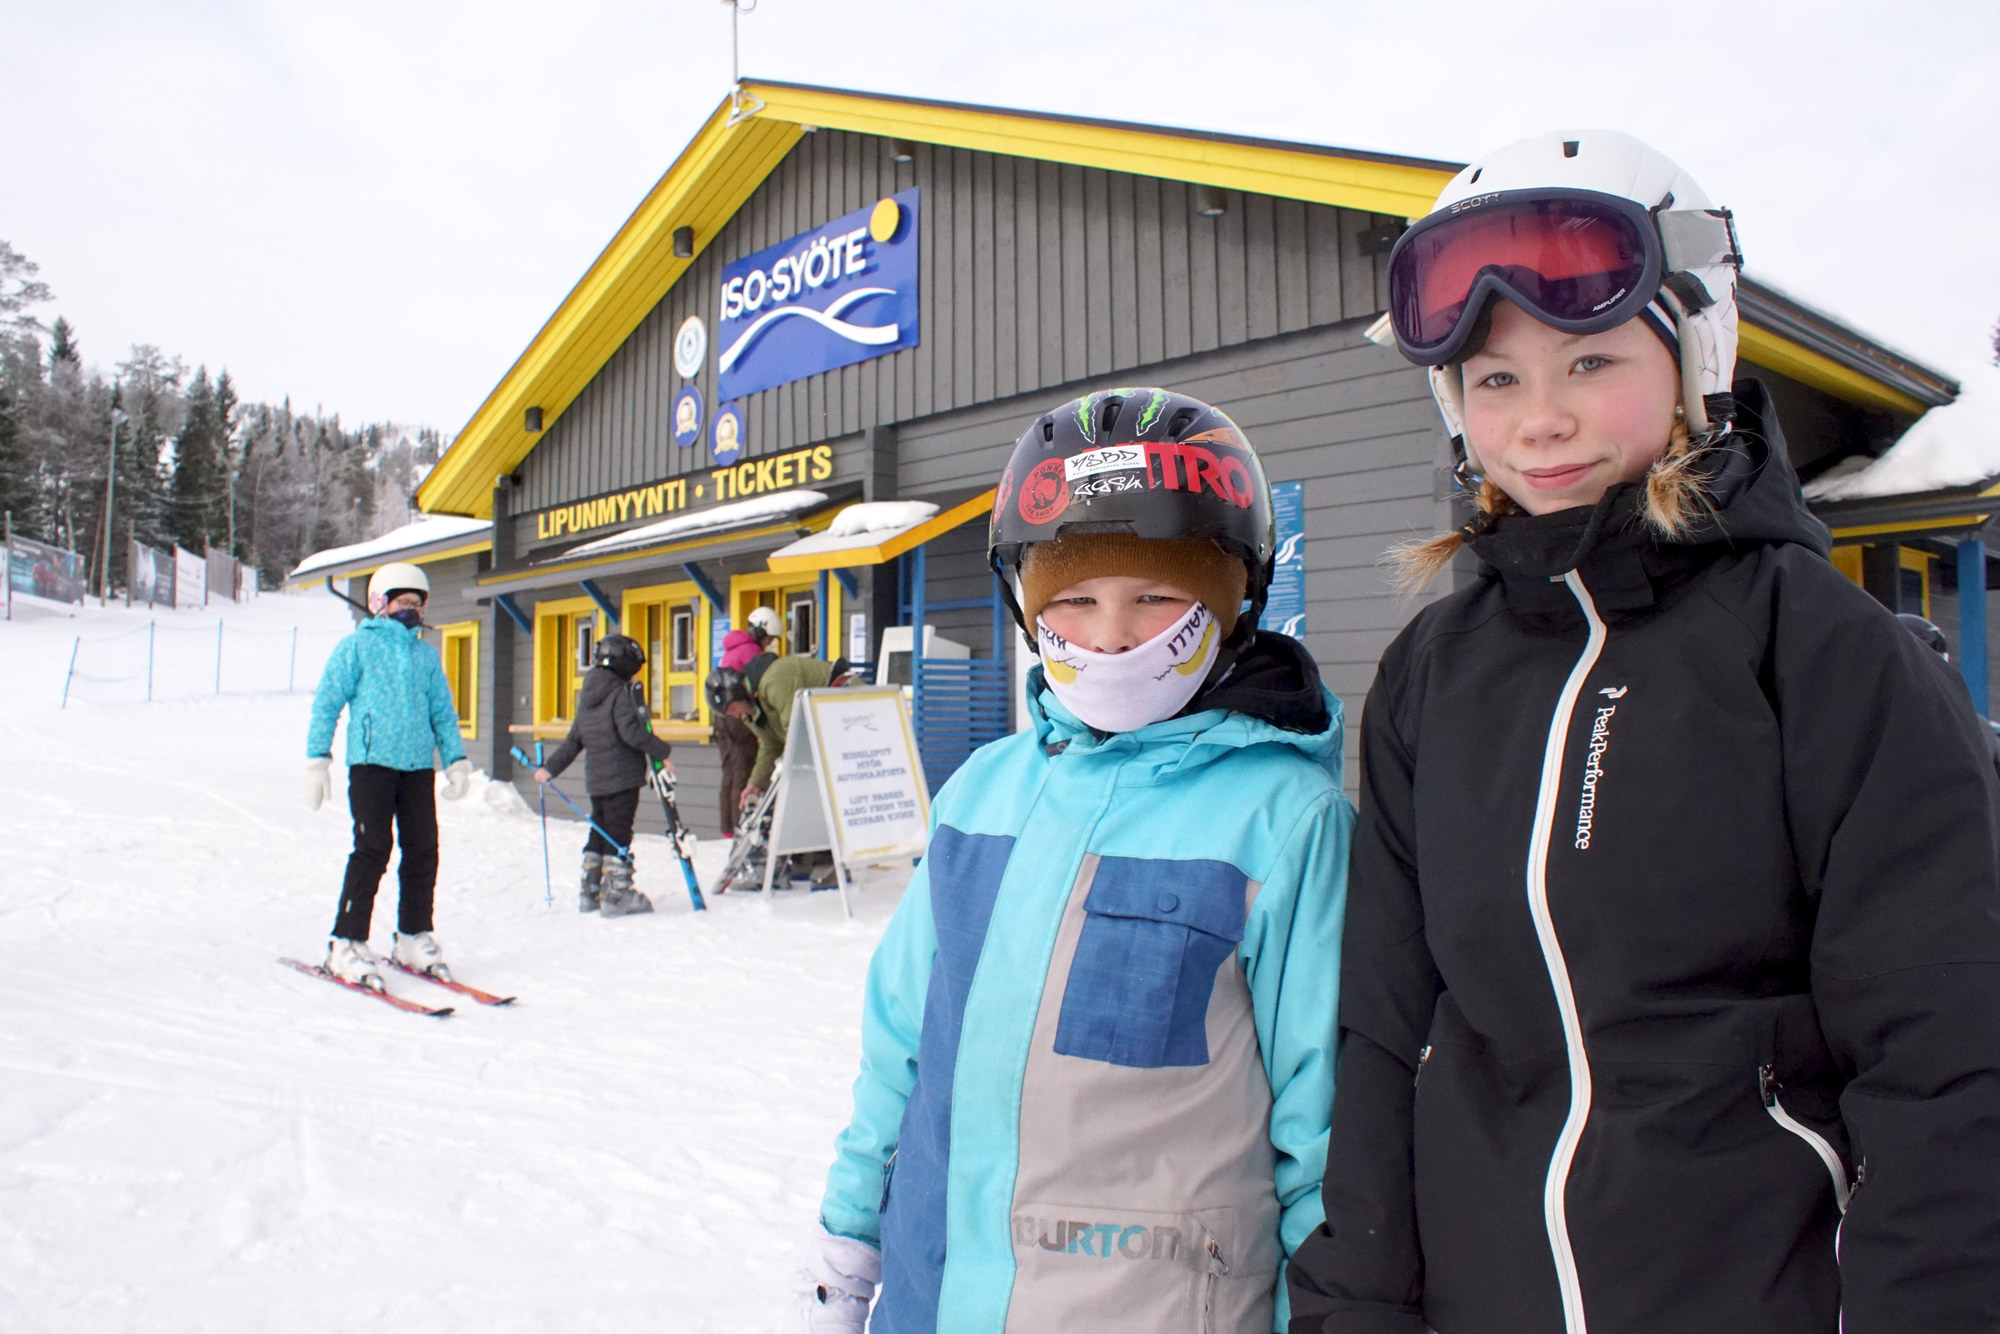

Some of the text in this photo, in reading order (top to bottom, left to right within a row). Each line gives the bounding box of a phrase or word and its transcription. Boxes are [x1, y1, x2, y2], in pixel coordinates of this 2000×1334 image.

[1450, 192, 1502, 214] SCOTT
[538, 445, 832, 540] LIPUNMYYNTI TICKETS
[1575, 705, 1616, 850] PeakPerformance
[844, 799, 916, 816] ALSO FROM THE
[849, 790, 904, 805] LIFT PASSES
[1011, 1215, 1183, 1261] BURTON
